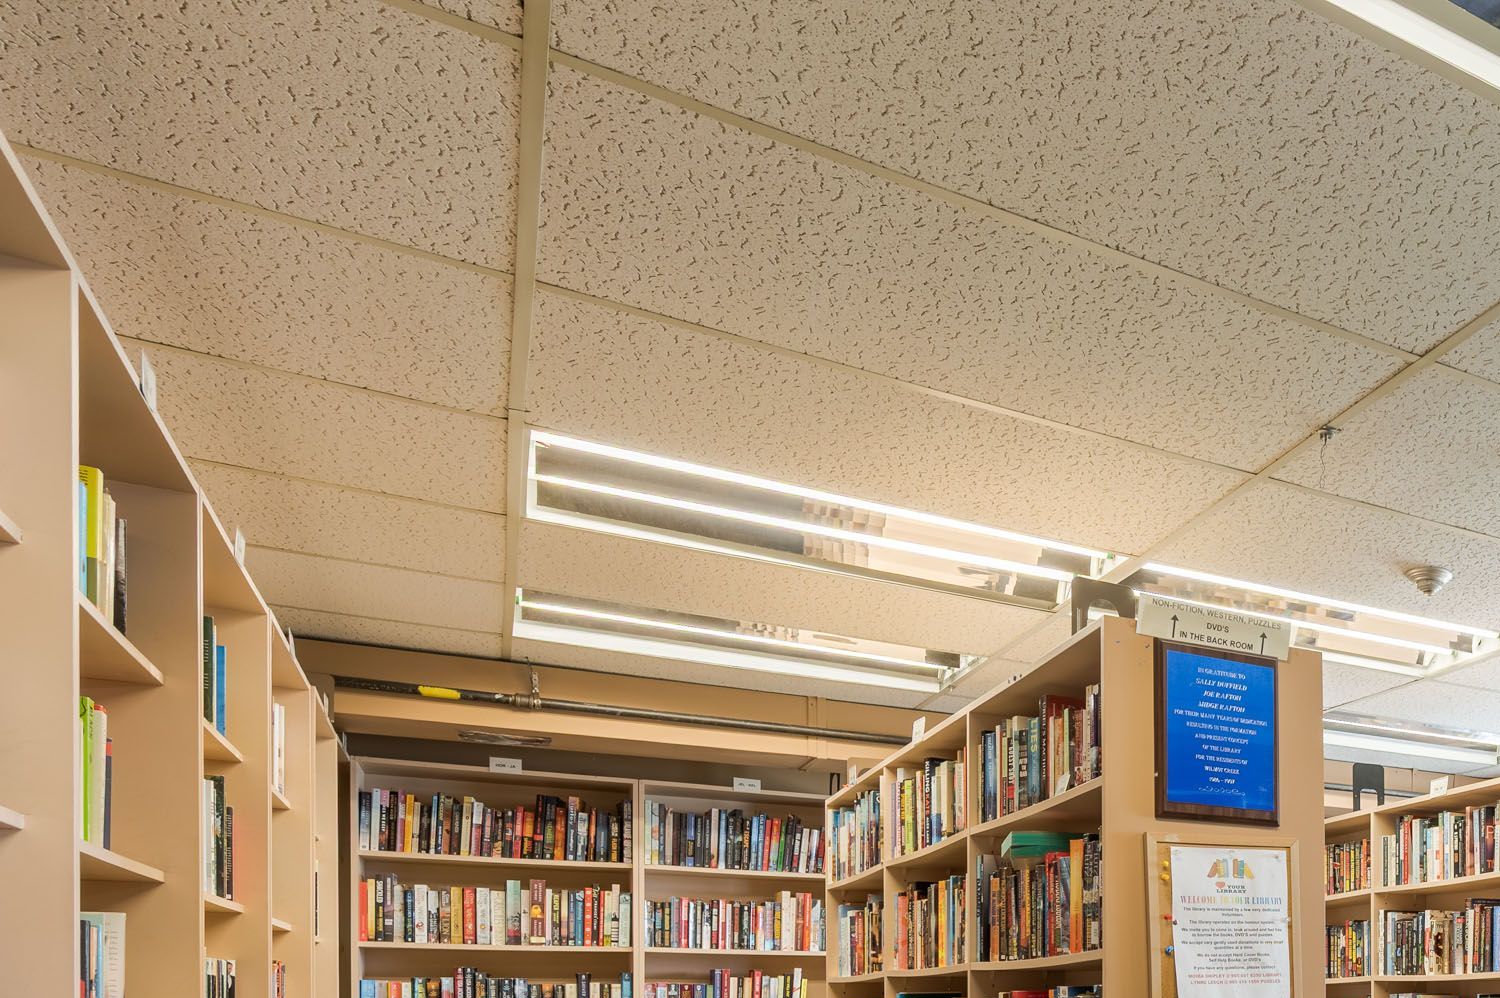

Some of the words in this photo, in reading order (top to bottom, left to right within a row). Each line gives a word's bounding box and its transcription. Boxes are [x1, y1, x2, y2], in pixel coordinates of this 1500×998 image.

[1206, 622, 1230, 633] DVD'S
[1248, 617, 1281, 630] PUZZLES
[1180, 630, 1188, 638] IN
[1190, 632, 1205, 642] THE
[1207, 635, 1228, 647] BACK
[1230, 640, 1254, 651] ROOM
[1238, 672, 1246, 680] TO
[1195, 677, 1216, 687] SALLY
[1217, 681, 1248, 691] DUFFIELD
[1203, 690, 1215, 698] JOE
[1030, 719, 1038, 753] LIES
[1180, 895, 1216, 904] WELCOME
[1252, 896, 1282, 905] LIBRARY
